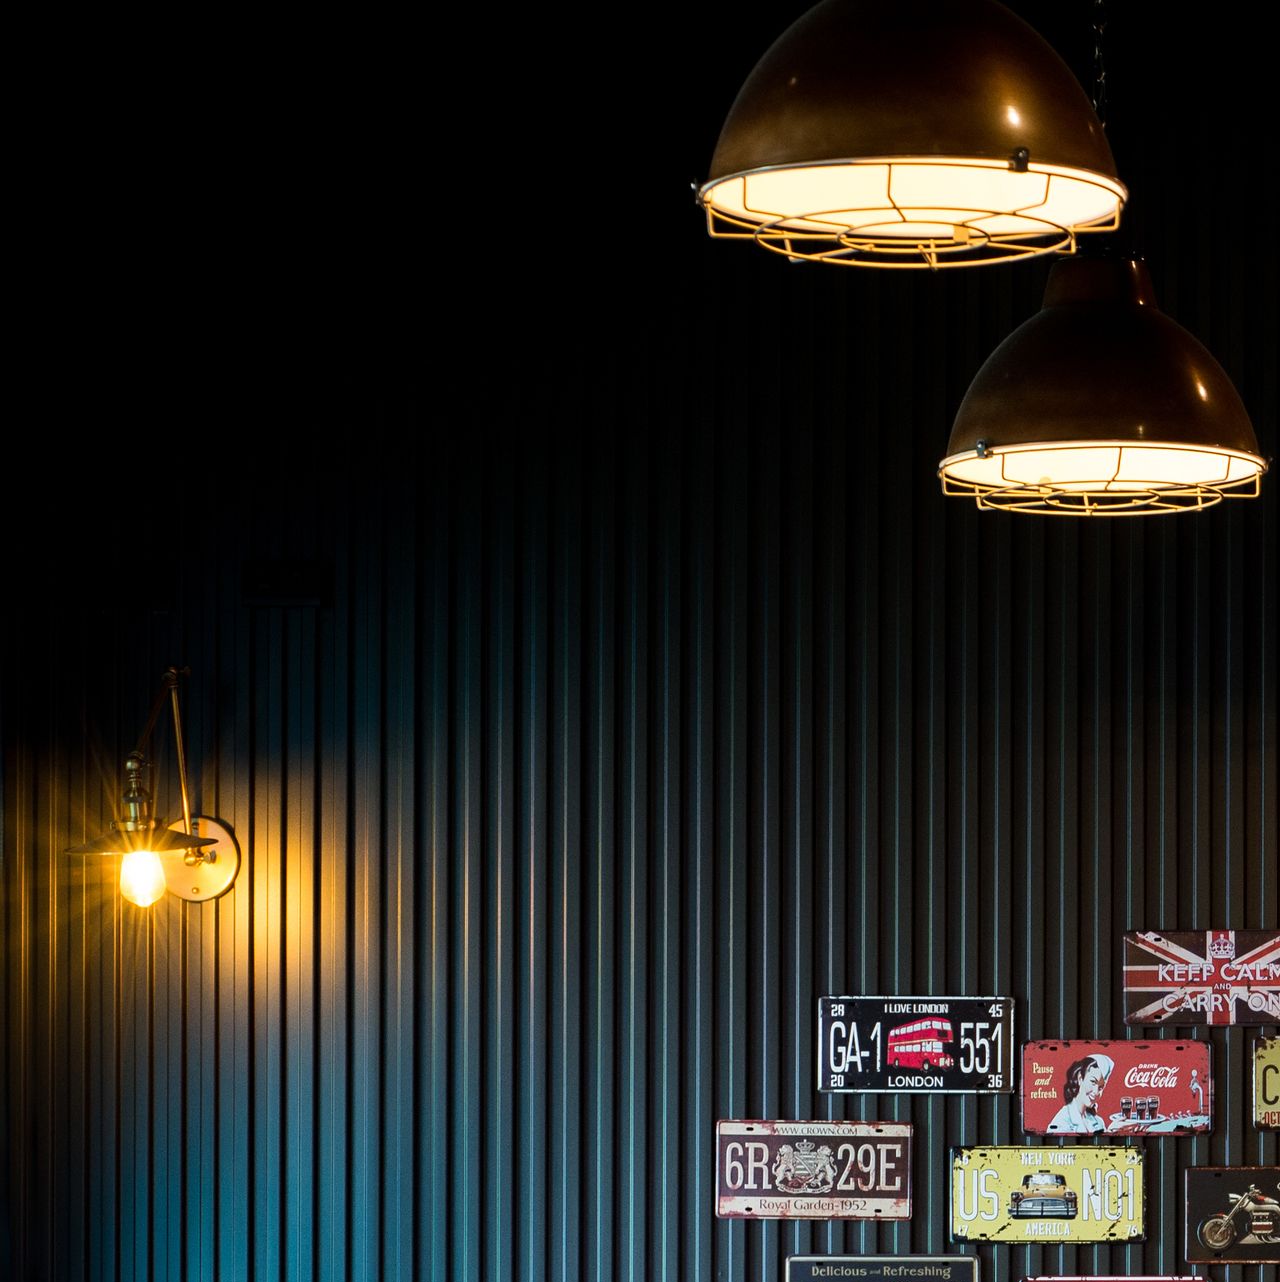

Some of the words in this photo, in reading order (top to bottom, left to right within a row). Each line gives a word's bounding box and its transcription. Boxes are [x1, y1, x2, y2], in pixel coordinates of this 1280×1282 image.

[1158, 963, 1215, 982] KEEP
[889, 1003, 912, 1013] LOVE
[913, 1003, 949, 1013] LONDON
[1162, 993, 1238, 1013] CARRY
[831, 1004, 845, 1017] 28
[988, 1004, 1003, 1017] 45
[829, 1021, 881, 1073] GA-1
[959, 1022, 1002, 1073] 551
[1032, 1062, 1054, 1074] Pause
[830, 1074, 844, 1087] 20
[888, 1076, 944, 1087] LONDON
[988, 1075, 1003, 1088] 36
[1034, 1075, 1052, 1086] and
[1124, 1065, 1180, 1088] Coca-Cola
[1030, 1087, 1057, 1099] refresh
[772, 1126, 858, 1136] WWW.CROWN.COM
[1020, 1152, 1043, 1165] NEW
[1048, 1152, 1076, 1165] YORK
[725, 1141, 773, 1190] 6R
[836, 1143, 902, 1192] 29E
[958, 1168, 999, 1221] US
[759, 1199, 791, 1212] Royal
[793, 1199, 868, 1212] Garden-1952
[1024, 1223, 1071, 1236] AMERICA
[811, 1266, 867, 1277] Delicious
[883, 1266, 952, 1279] Refreshing
